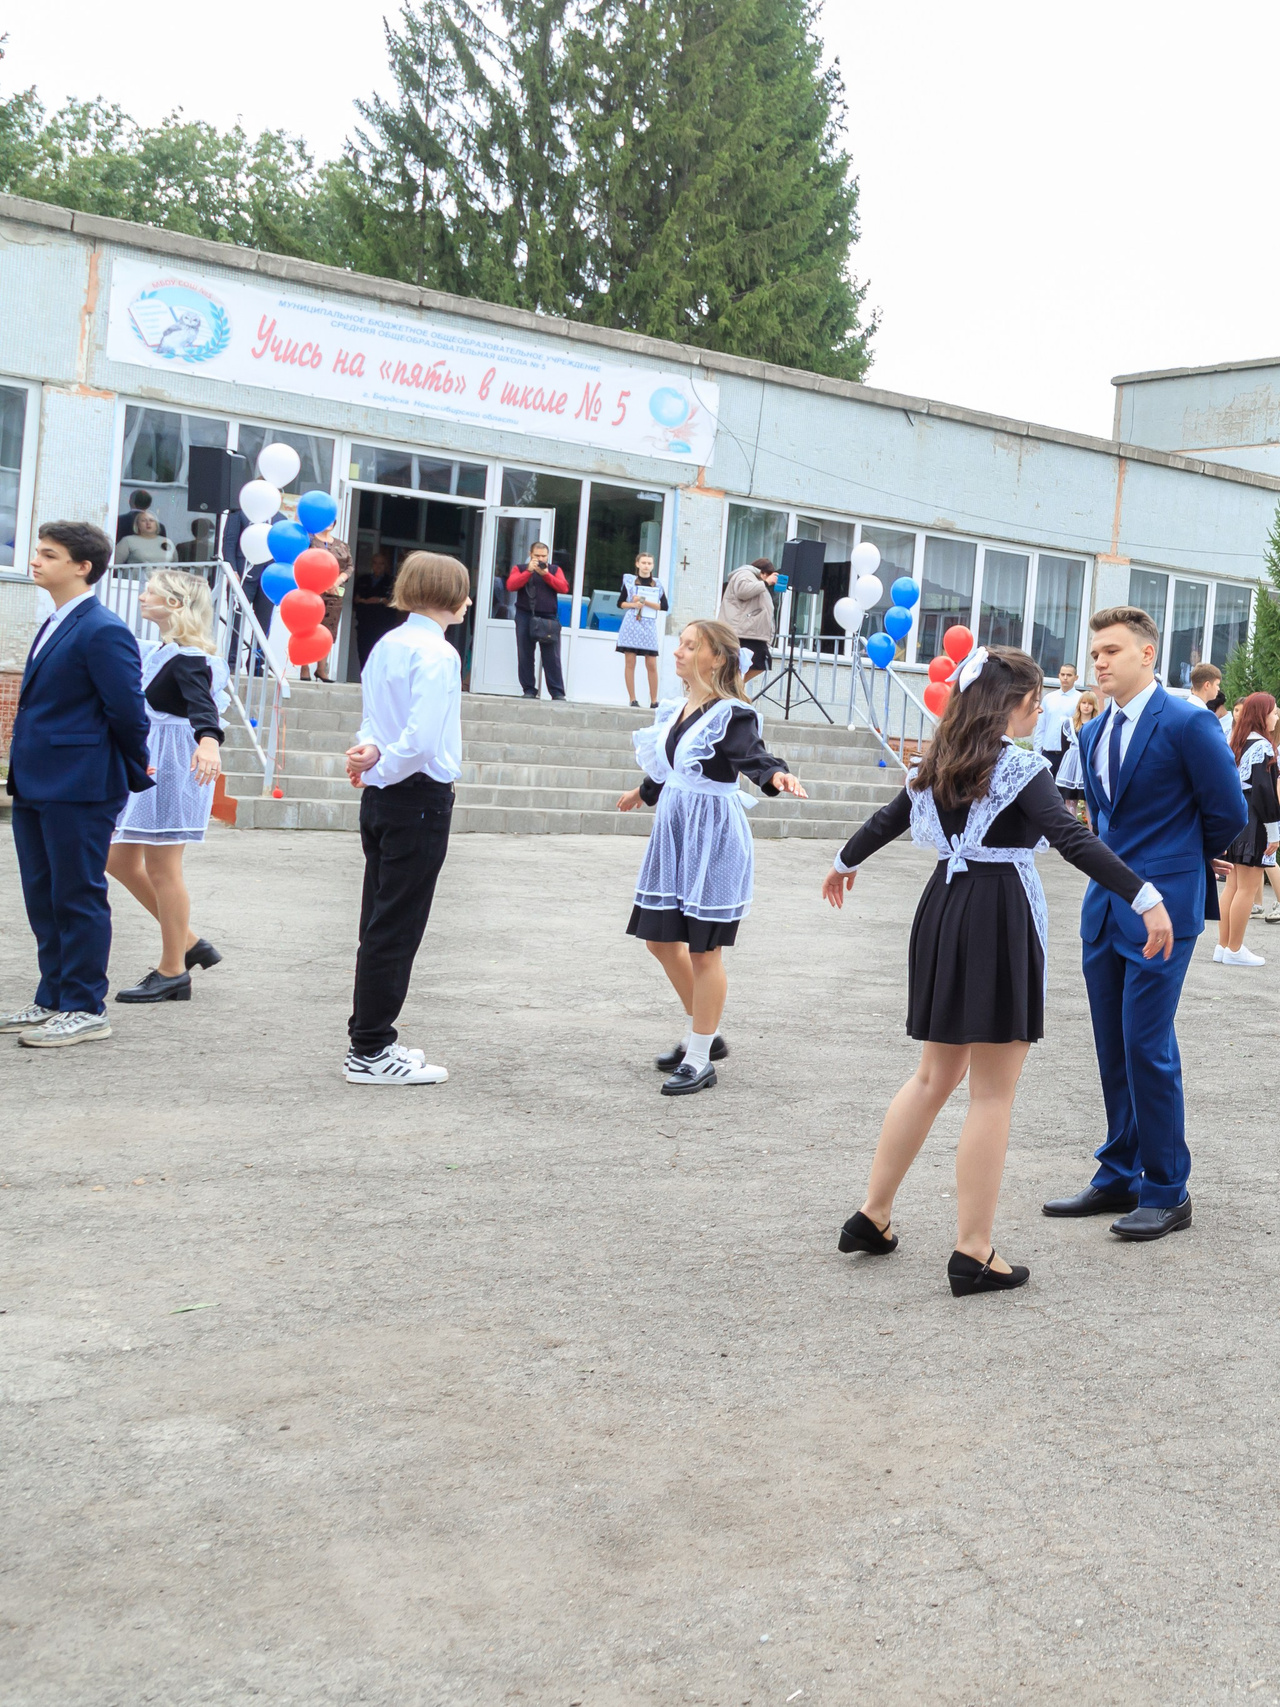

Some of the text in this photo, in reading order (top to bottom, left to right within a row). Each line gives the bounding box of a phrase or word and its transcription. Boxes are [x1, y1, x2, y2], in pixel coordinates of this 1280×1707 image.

[278, 300, 601, 373] МУНИЦИПАЛЬНОЕ БЮДЖЕТНОЕ ОБЩЕОБРАЗОВАТЕЛЬНОЕ УЧРЕЖДЕНИЕ
[330, 320, 376, 336] СРЕДНЯЯ
[378, 329, 496, 359] ОБЩЕОБРАЗОВАТЕЛЬНАЯ
[497, 352, 528, 367] ШКОЛА
[251, 313, 631, 426] Учись на «пять» в школе № 5
[413, 399, 481, 419] Новосибирской
[481, 413, 520, 425] области
